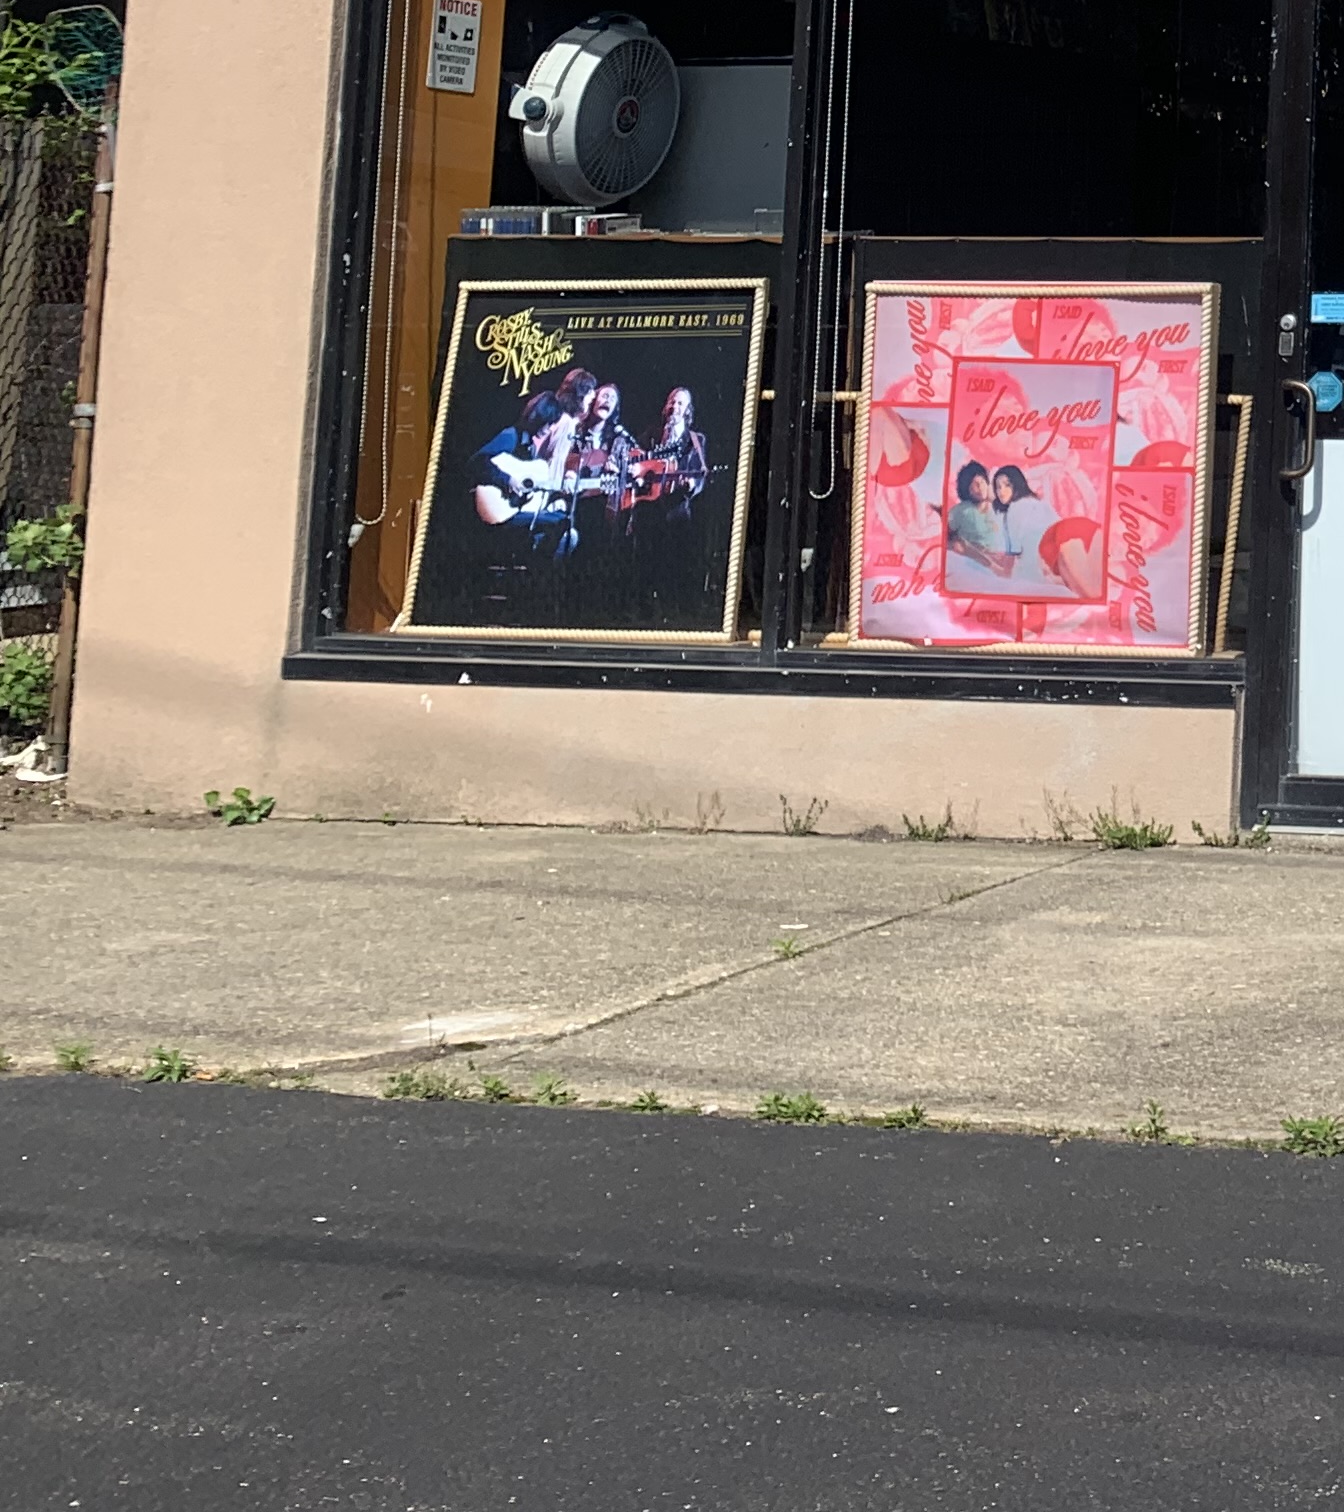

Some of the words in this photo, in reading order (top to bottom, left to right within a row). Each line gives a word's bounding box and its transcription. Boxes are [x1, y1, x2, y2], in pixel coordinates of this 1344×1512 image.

[440, 74, 463, 85] CAMERA
[567, 316, 594, 329] LIVE
[598, 317, 613, 329] AT
[616, 315, 675, 329] FILLMORE
[716, 313, 745, 326] 1969
[907, 300, 953, 358] you
[1058, 306, 1082, 319] SAID
[500, 333, 556, 386] NASH
[1067, 311, 1128, 360] love
[1119, 322, 1190, 383] you
[1158, 360, 1188, 374] FIRST
[971, 379, 995, 392] SAID
[963, 408, 980, 442] i
[980, 385, 1040, 439] love
[1024, 399, 1101, 458] you
[1069, 436, 1098, 449] FIRST
[1118, 501, 1169, 569] love
[1108, 572, 1157, 632] you
